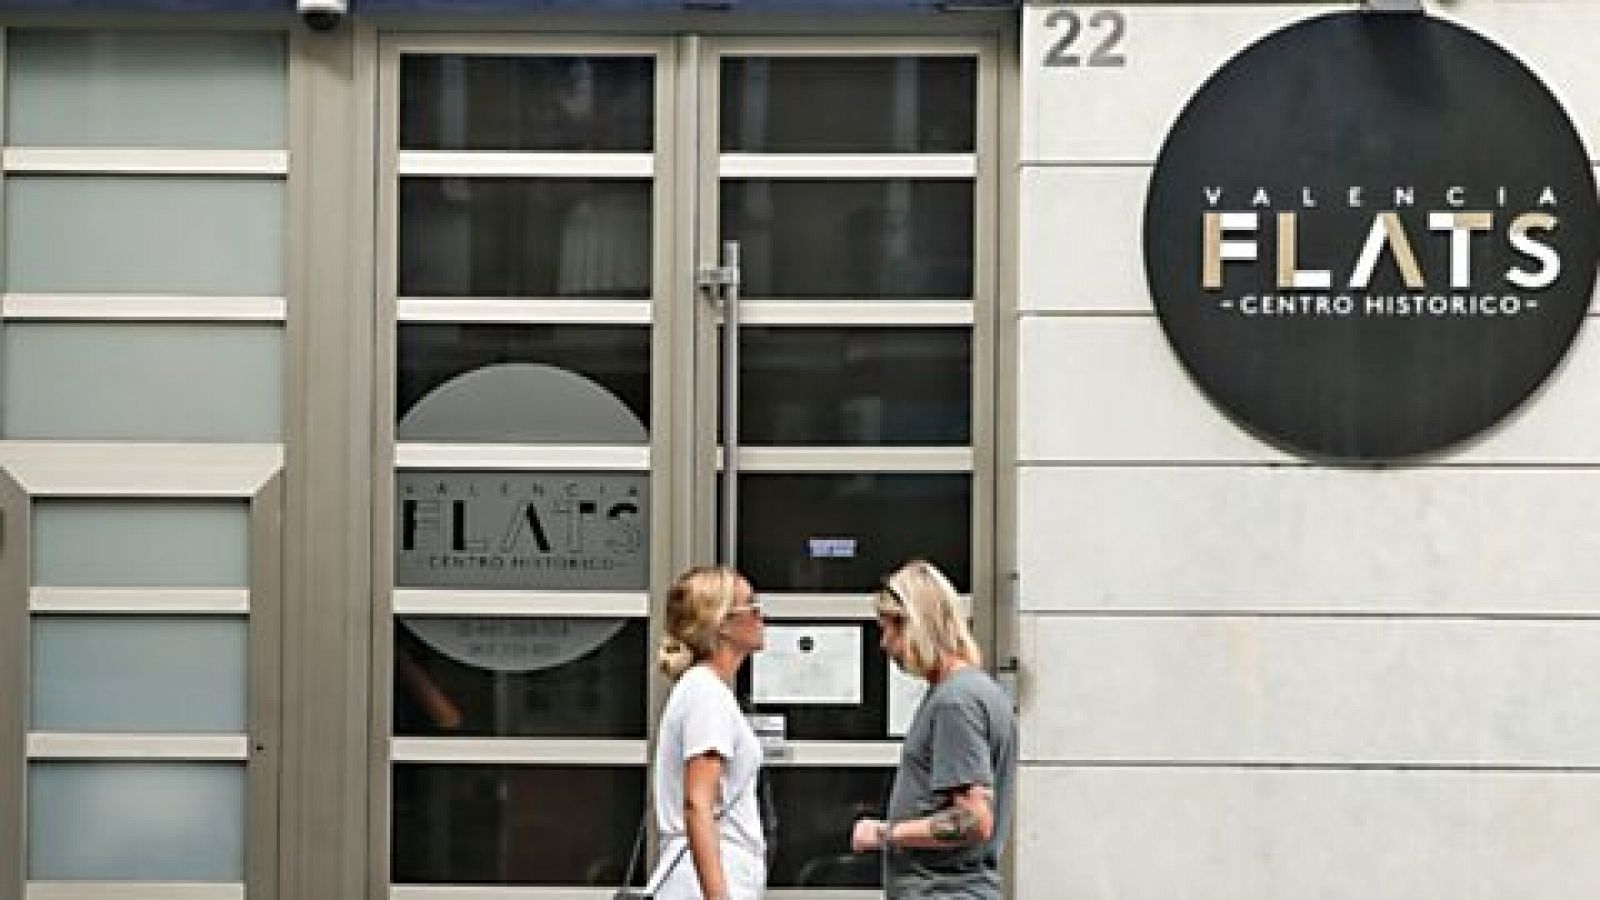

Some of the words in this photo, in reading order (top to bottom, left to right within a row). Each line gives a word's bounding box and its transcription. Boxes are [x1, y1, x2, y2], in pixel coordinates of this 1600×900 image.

[1042, 9, 1128, 68] 22
[1205, 186, 1558, 207] VALENCIA
[1202, 210, 1562, 288] FLATS
